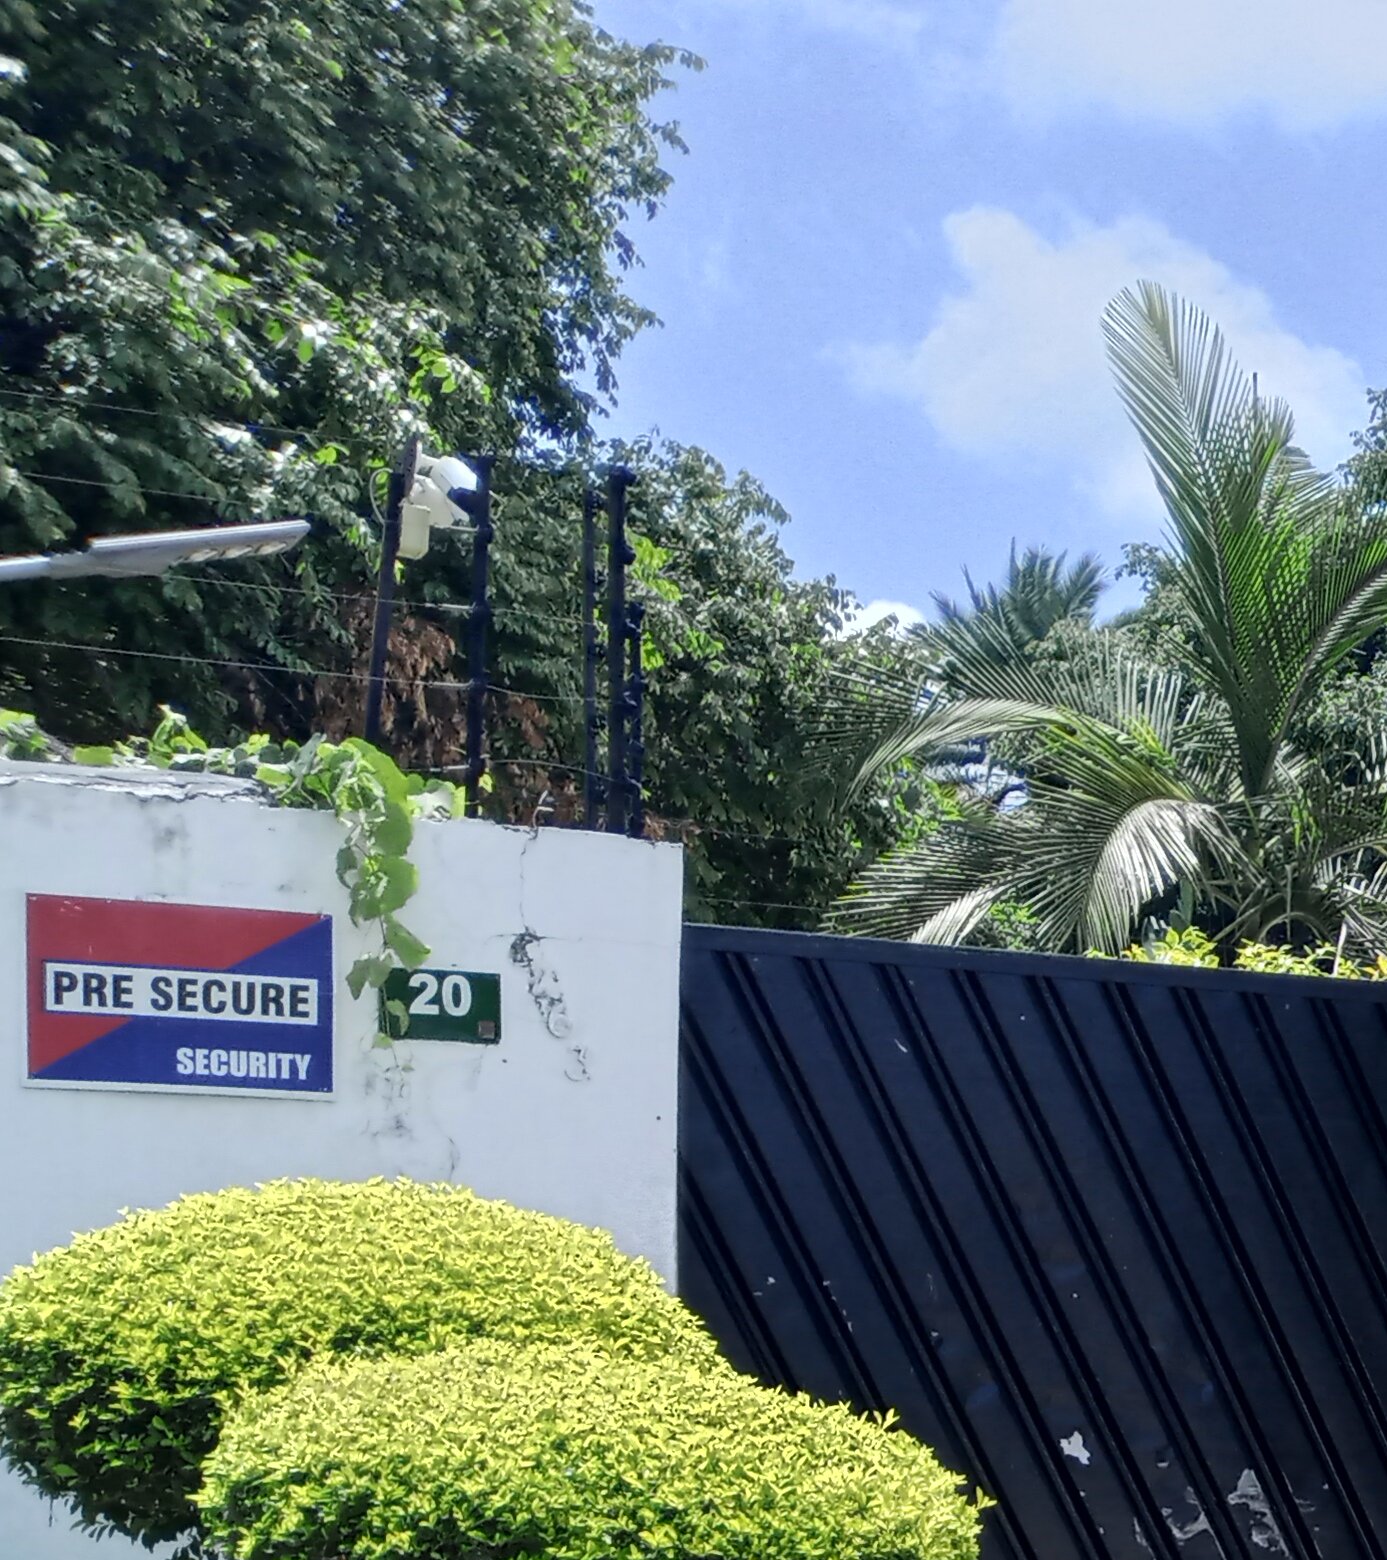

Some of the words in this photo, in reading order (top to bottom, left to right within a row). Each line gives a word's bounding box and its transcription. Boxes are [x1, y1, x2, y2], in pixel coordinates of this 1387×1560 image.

[53, 970, 134, 1008] PRE
[150, 975, 311, 1019] SECURE
[408, 973, 473, 1016] 20
[176, 1047, 312, 1080] SECURITY
